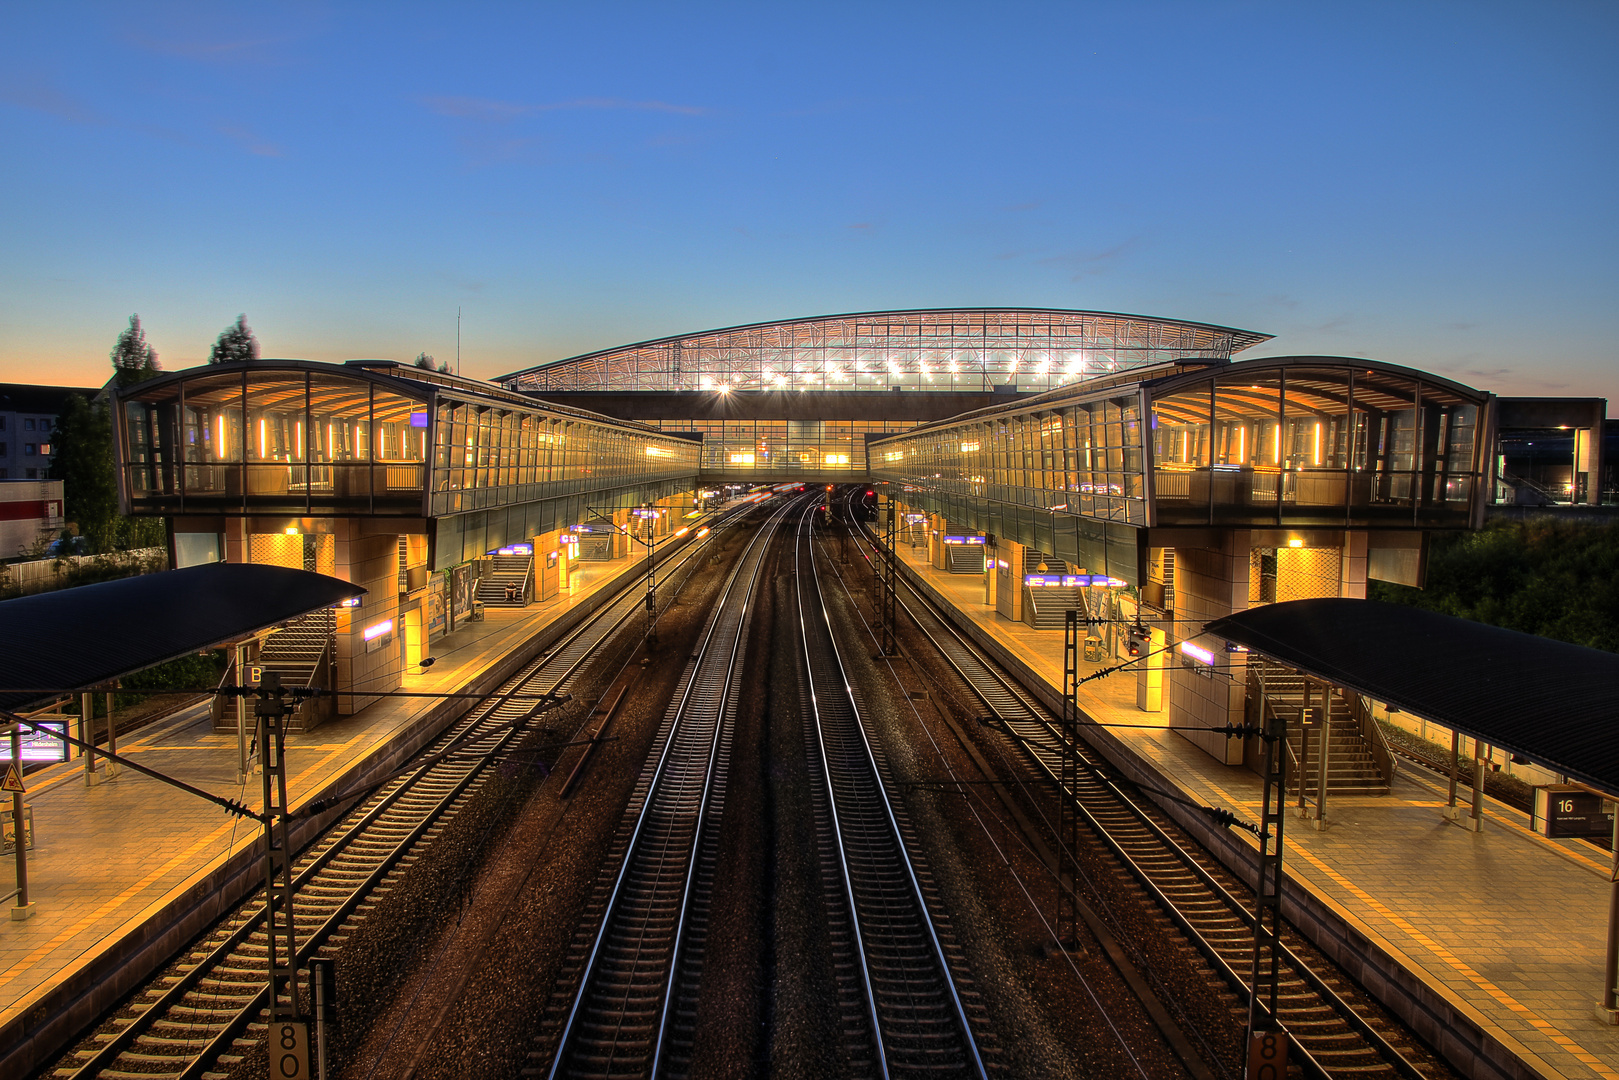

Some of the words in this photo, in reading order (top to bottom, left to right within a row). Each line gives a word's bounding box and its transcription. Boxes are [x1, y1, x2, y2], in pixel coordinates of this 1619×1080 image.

[251, 667, 261, 683] B
[1303, 708, 1313, 725] E
[1558, 800, 1574, 813] 16
